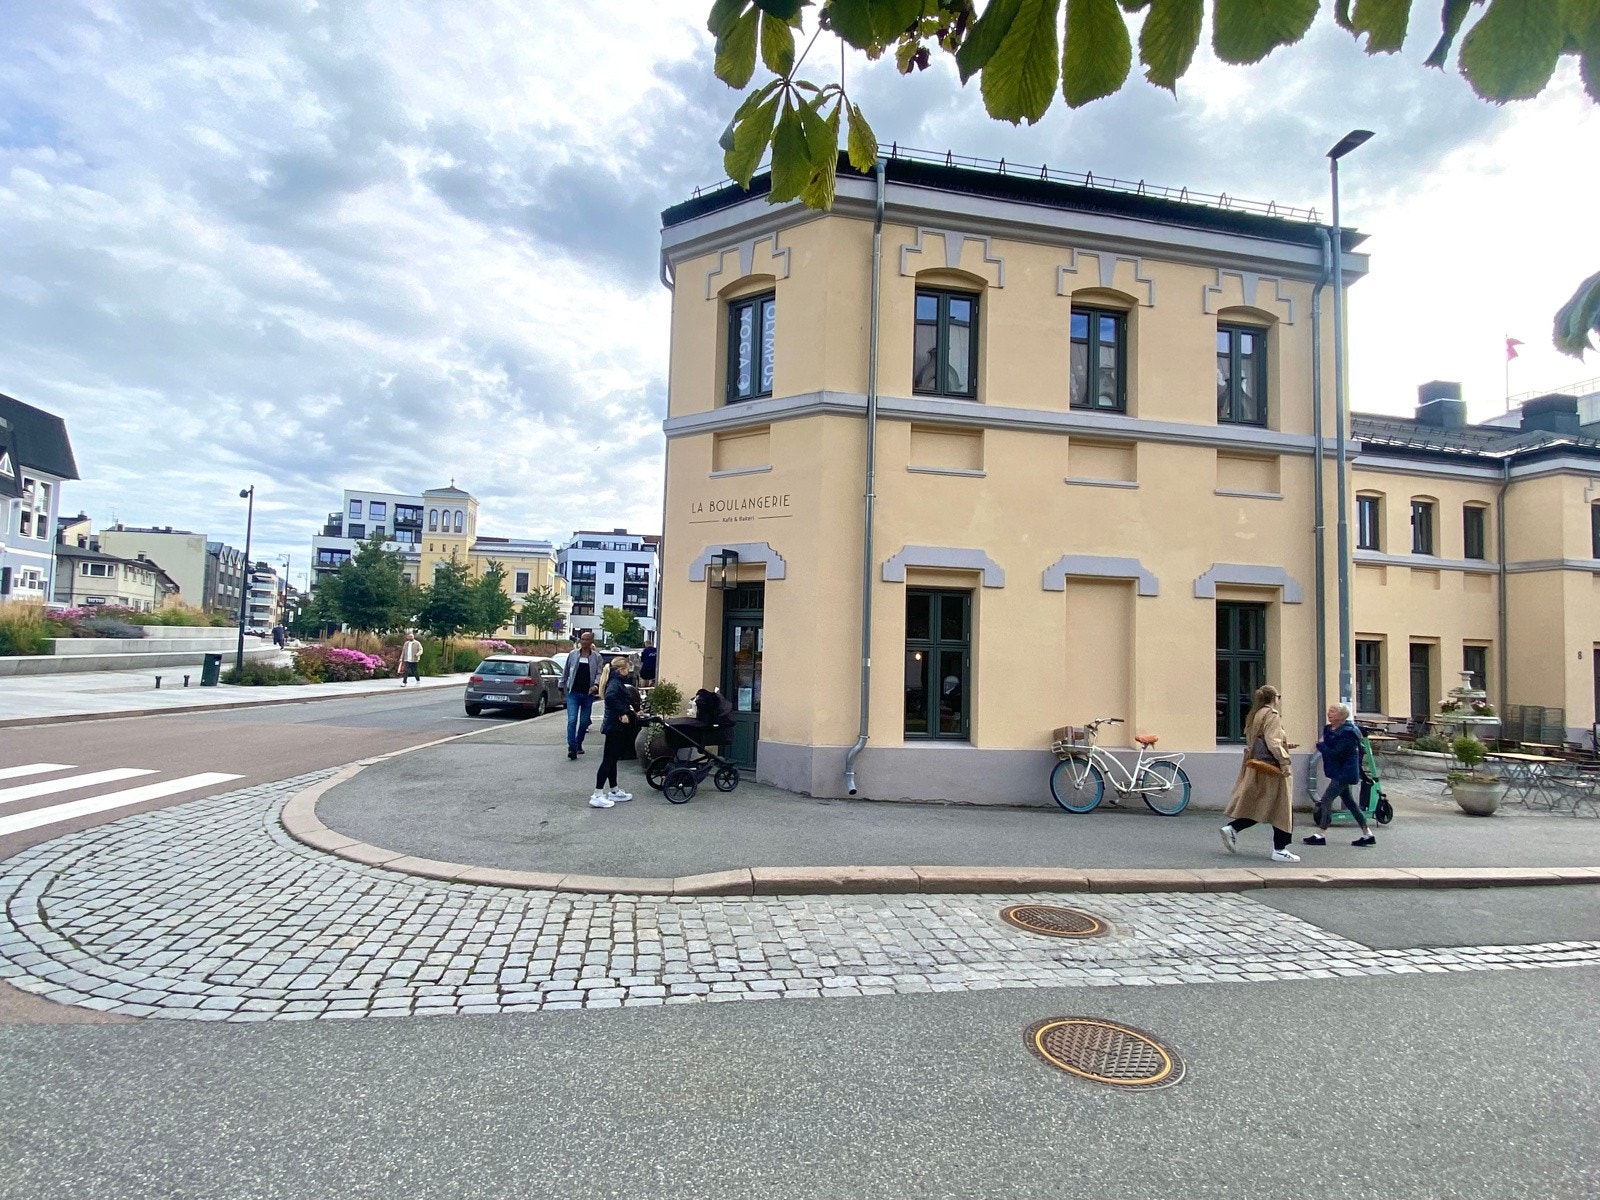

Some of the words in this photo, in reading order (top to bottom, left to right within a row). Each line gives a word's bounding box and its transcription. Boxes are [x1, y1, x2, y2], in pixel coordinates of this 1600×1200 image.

[739, 311, 752, 368] YOGA
[691, 502, 703, 514] LA
[709, 494, 790, 512] BOULANGERIE
